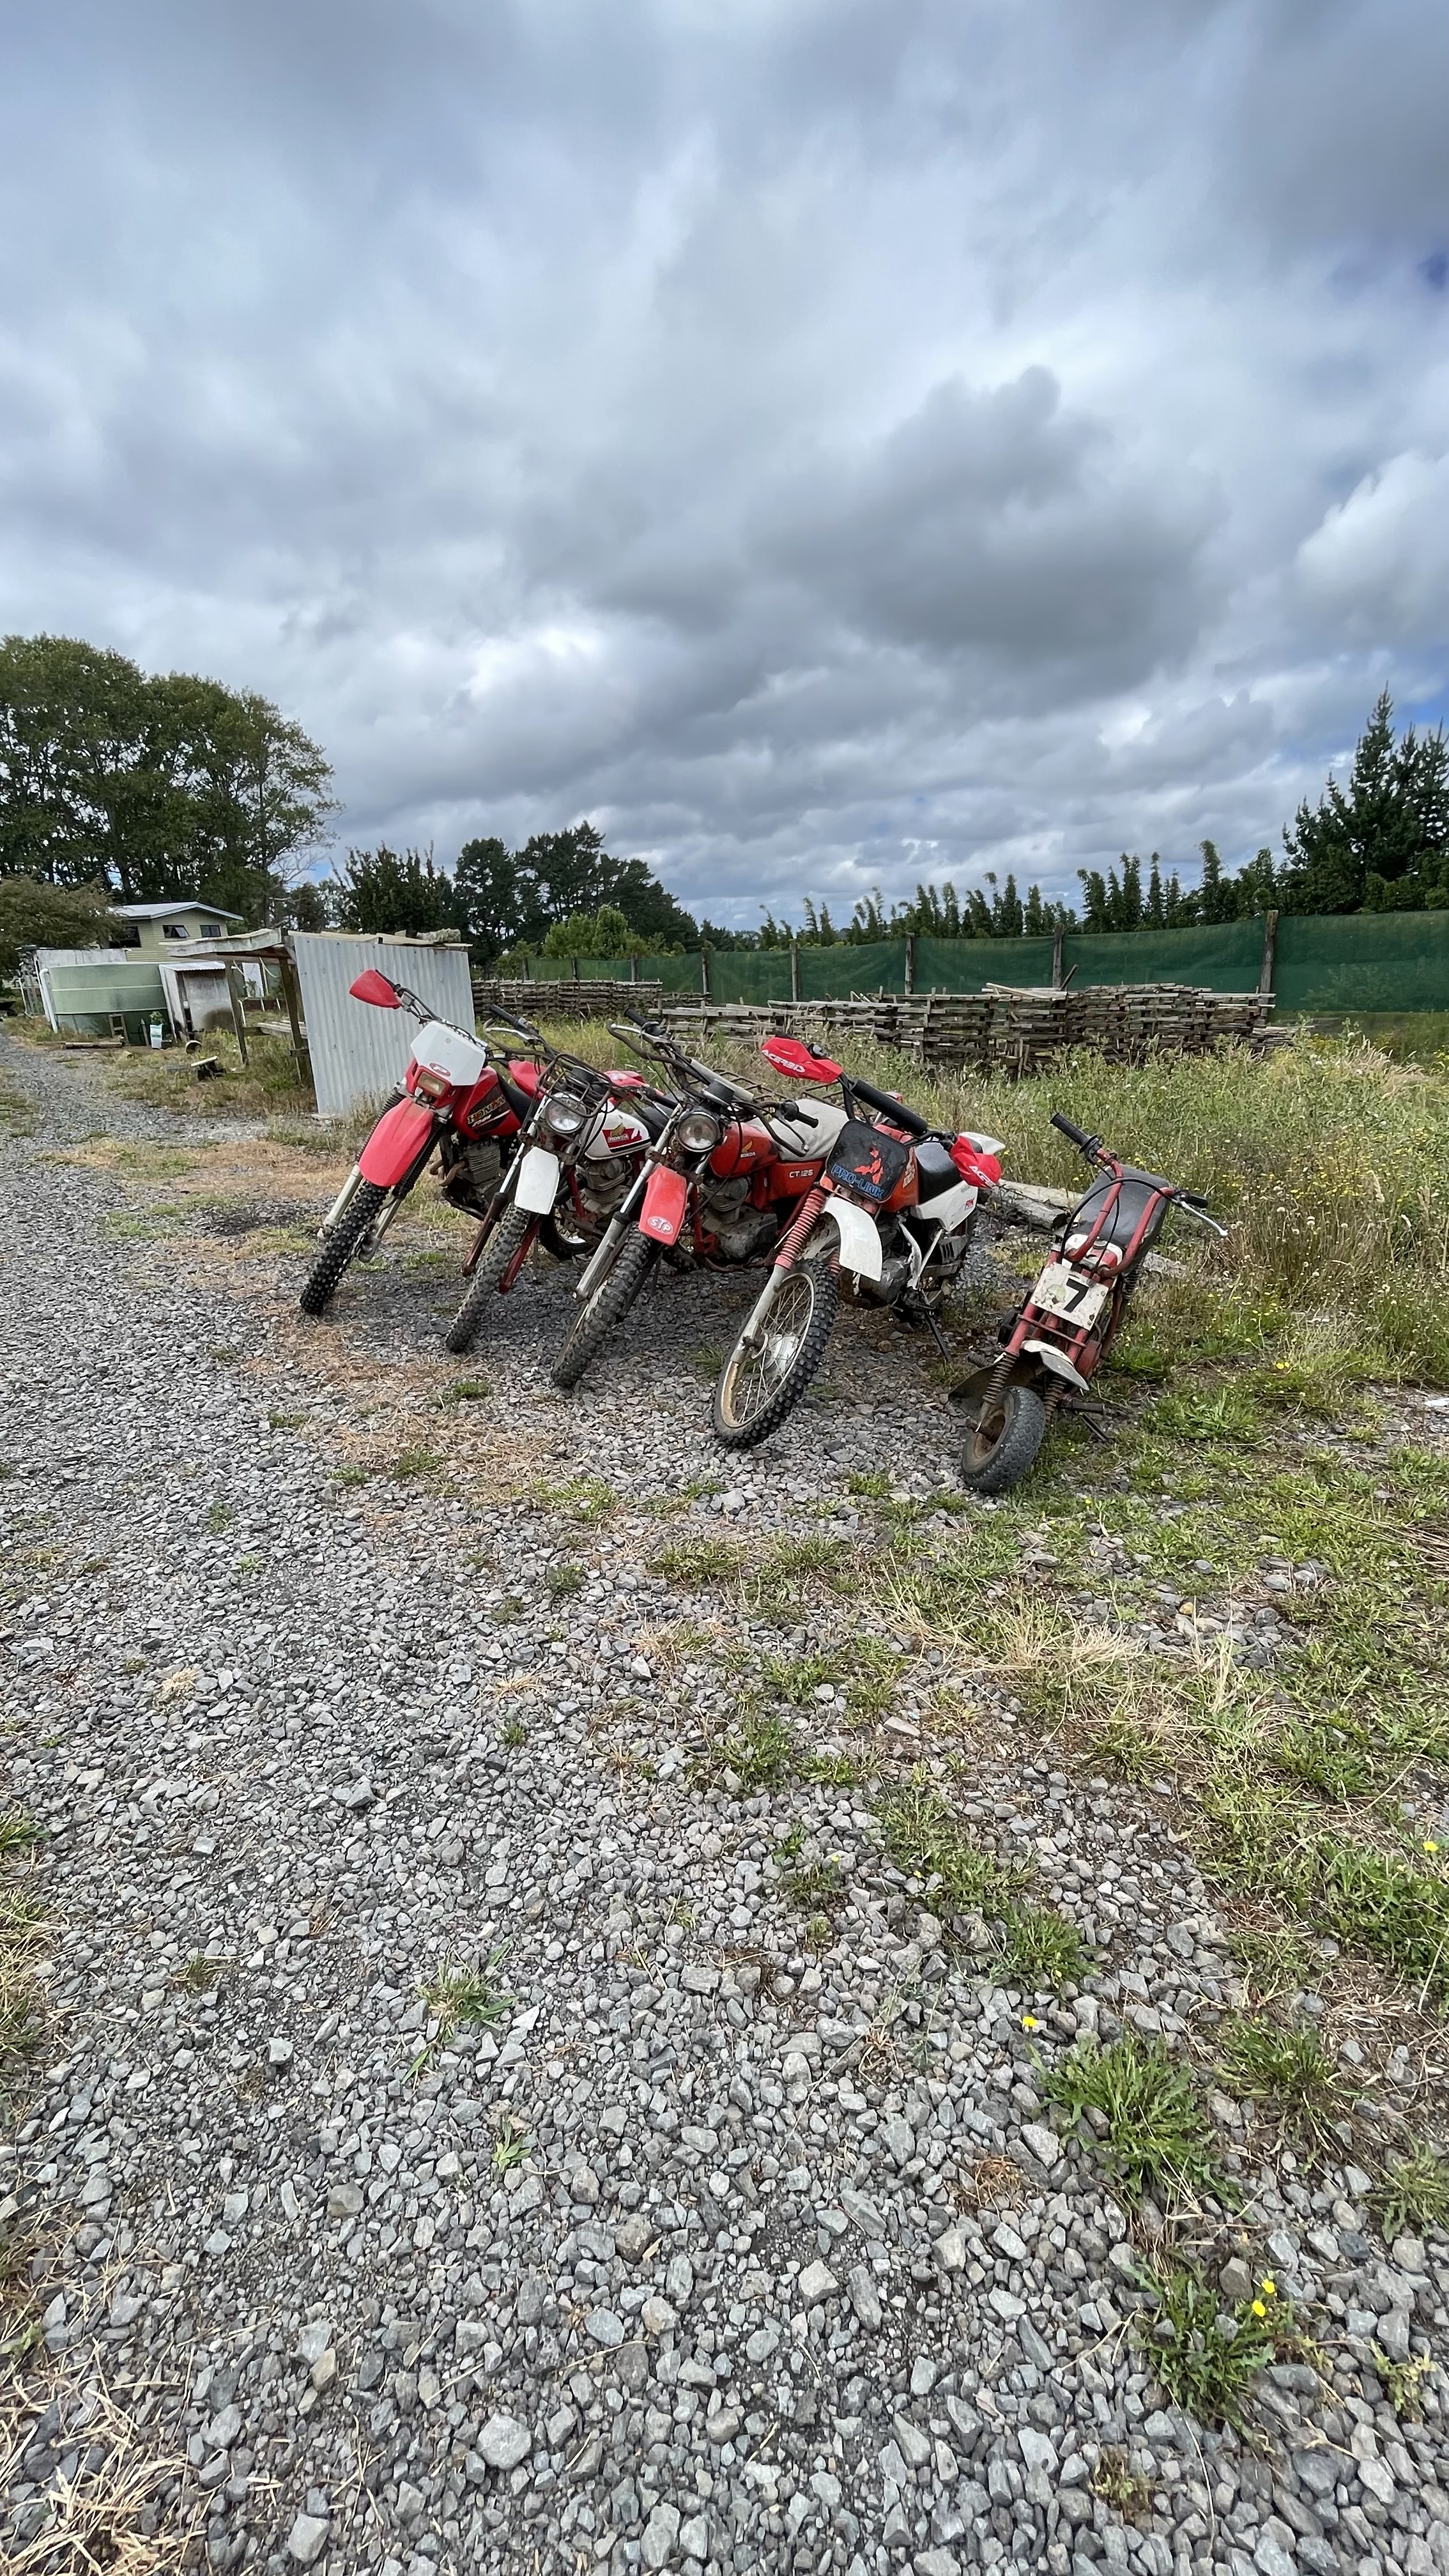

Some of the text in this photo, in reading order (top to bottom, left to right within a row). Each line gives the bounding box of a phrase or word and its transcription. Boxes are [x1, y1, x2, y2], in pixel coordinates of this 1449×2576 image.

[467, 1096, 505, 1124] HONDA
[831, 1164, 884, 1199] PRO-LINK
[650, 1218, 671, 1232] STP
[1062, 1277, 1090, 1314] 7
